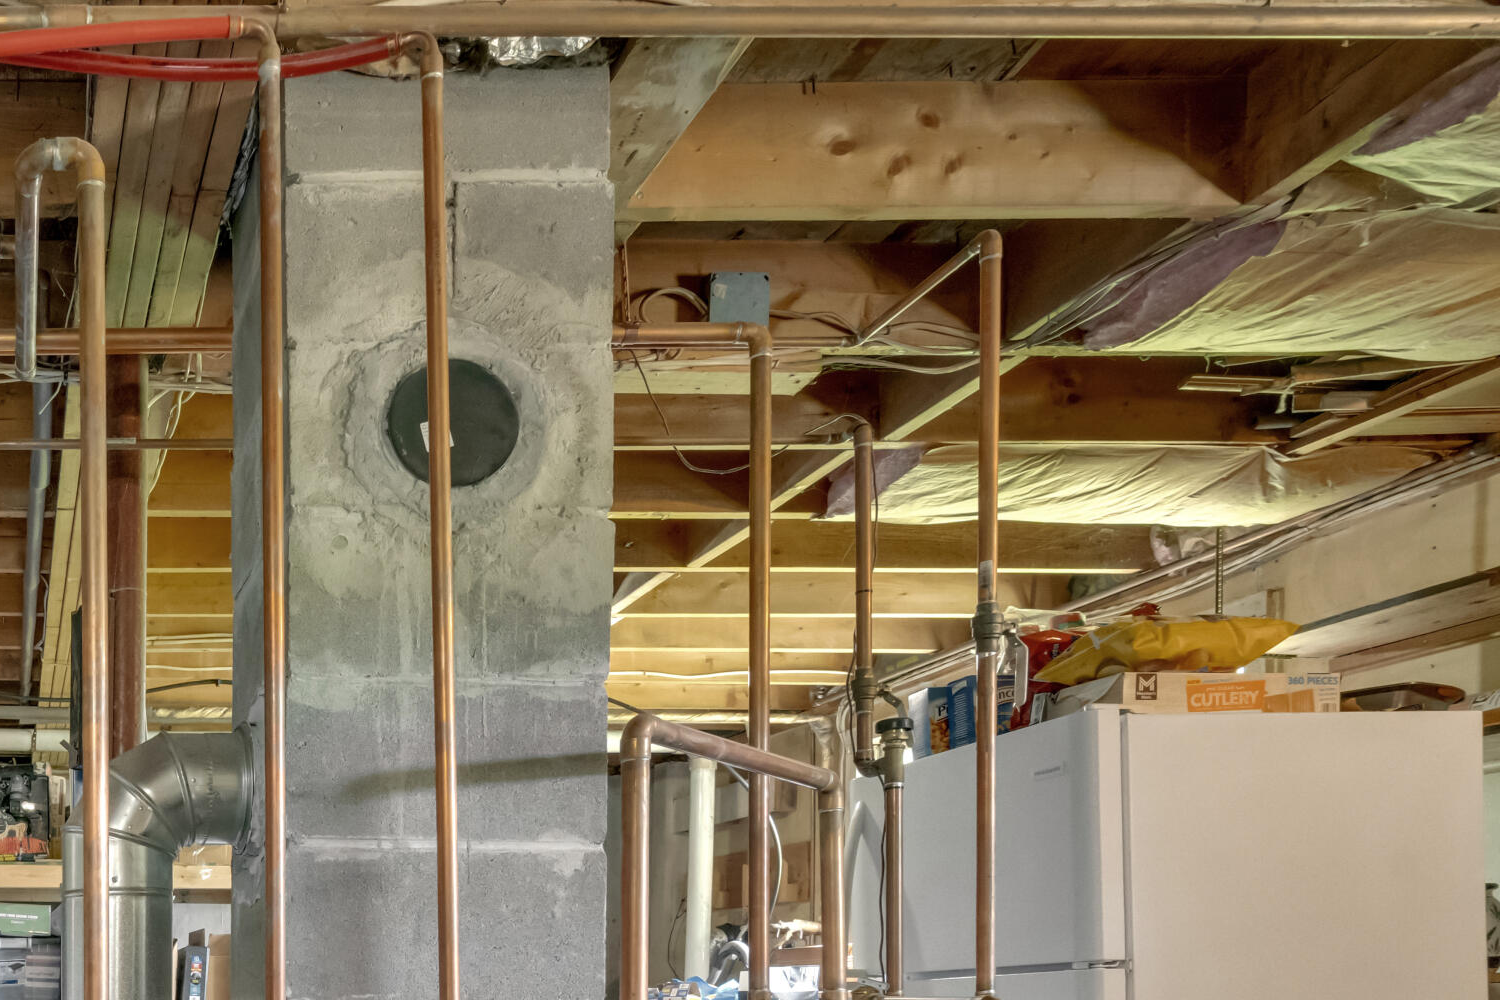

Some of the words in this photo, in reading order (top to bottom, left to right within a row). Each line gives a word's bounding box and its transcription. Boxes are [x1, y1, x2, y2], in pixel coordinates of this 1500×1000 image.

[1288, 676, 1304, 686] 360
[1306, 675, 1339, 686] PIECES
[1190, 690, 1260, 708] CUTLERY
